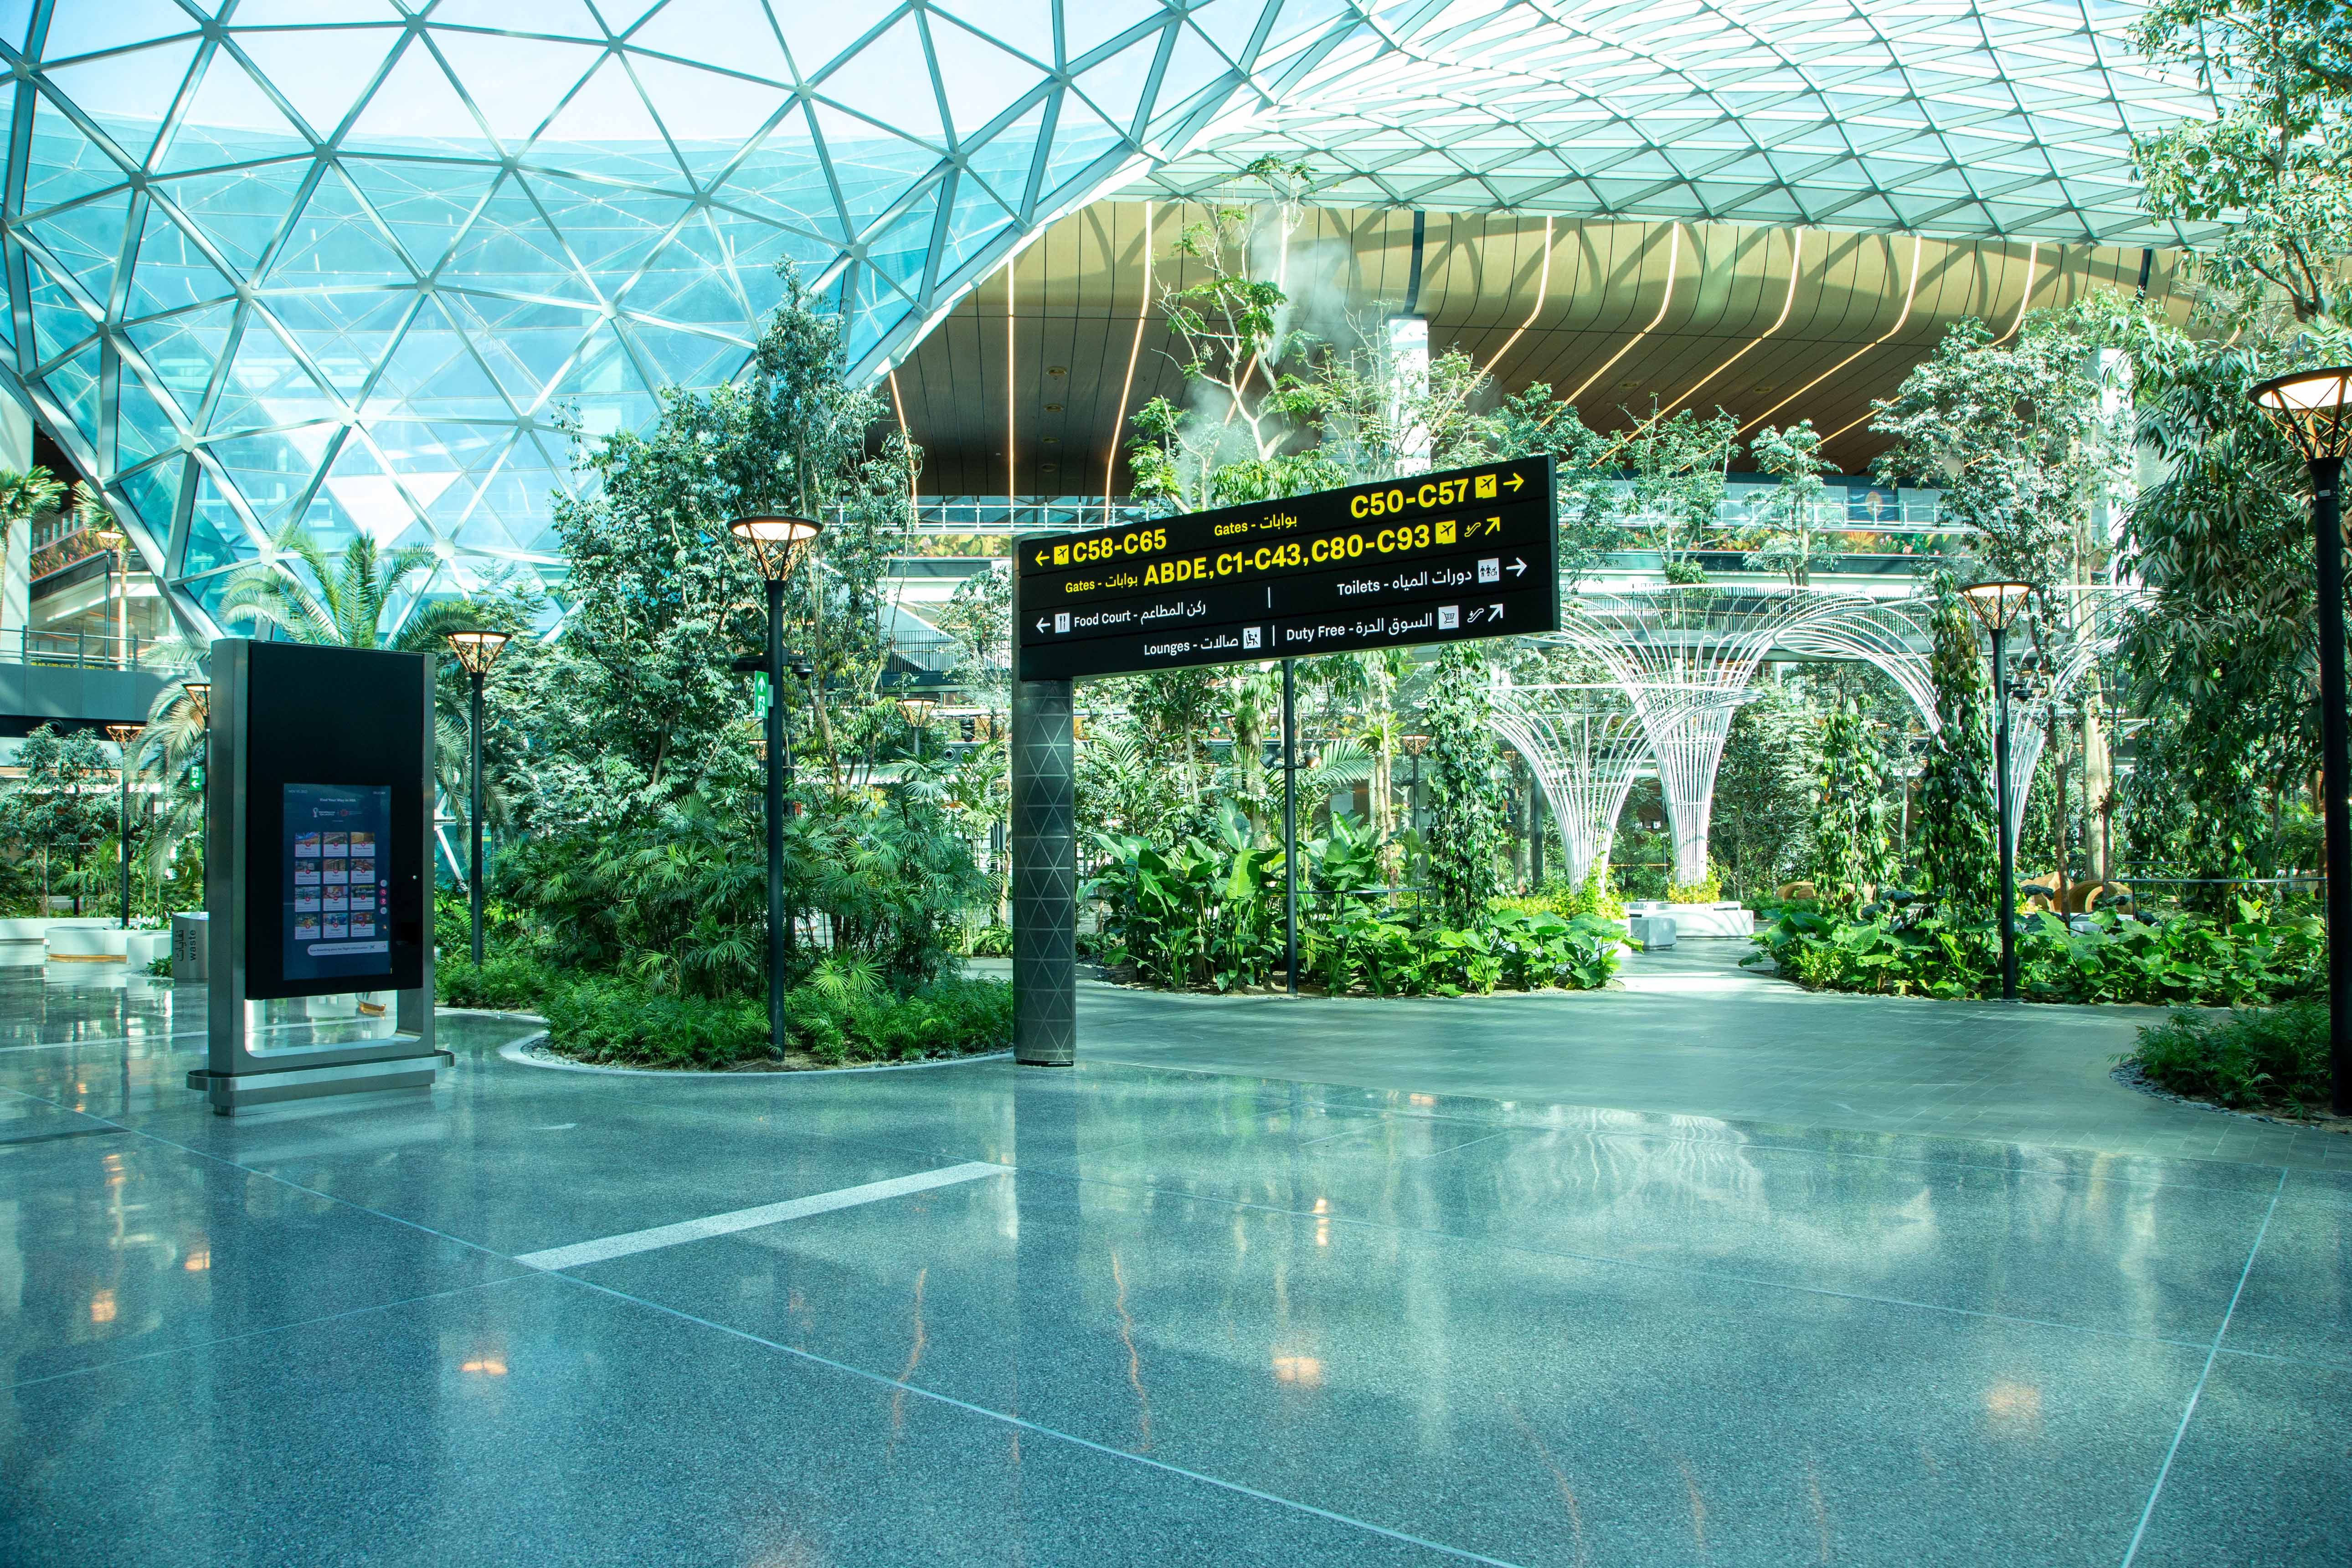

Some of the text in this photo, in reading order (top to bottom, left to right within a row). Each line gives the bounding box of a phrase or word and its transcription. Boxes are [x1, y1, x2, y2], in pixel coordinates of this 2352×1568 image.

[1351, 478, 1469, 519] C50-C57
[1214, 522, 1248, 536] Gates
[1260, 513, 1297, 530] بوابات
[1073, 528, 1167, 562] C58-C65
[1065, 581, 1095, 593] Gates
[1105, 572, 1137, 588] بوابات
[1337, 580, 1380, 596] Toilets
[1392, 568, 1472, 591] دورات المياه
[1074, 612, 1099, 627] Food
[1101, 610, 1131, 624] Court
[1140, 600, 1206, 625] ركن المطاعم
[1356, 612, 1432, 637] السوق الحرة
[1200, 635, 1239, 649] صالات
[1287, 627, 1315, 642] Duty
[1318, 626, 1345, 637] Free
[1144, 642, 1190, 656] Lounges
[175, 930, 187, 961] نفايات
